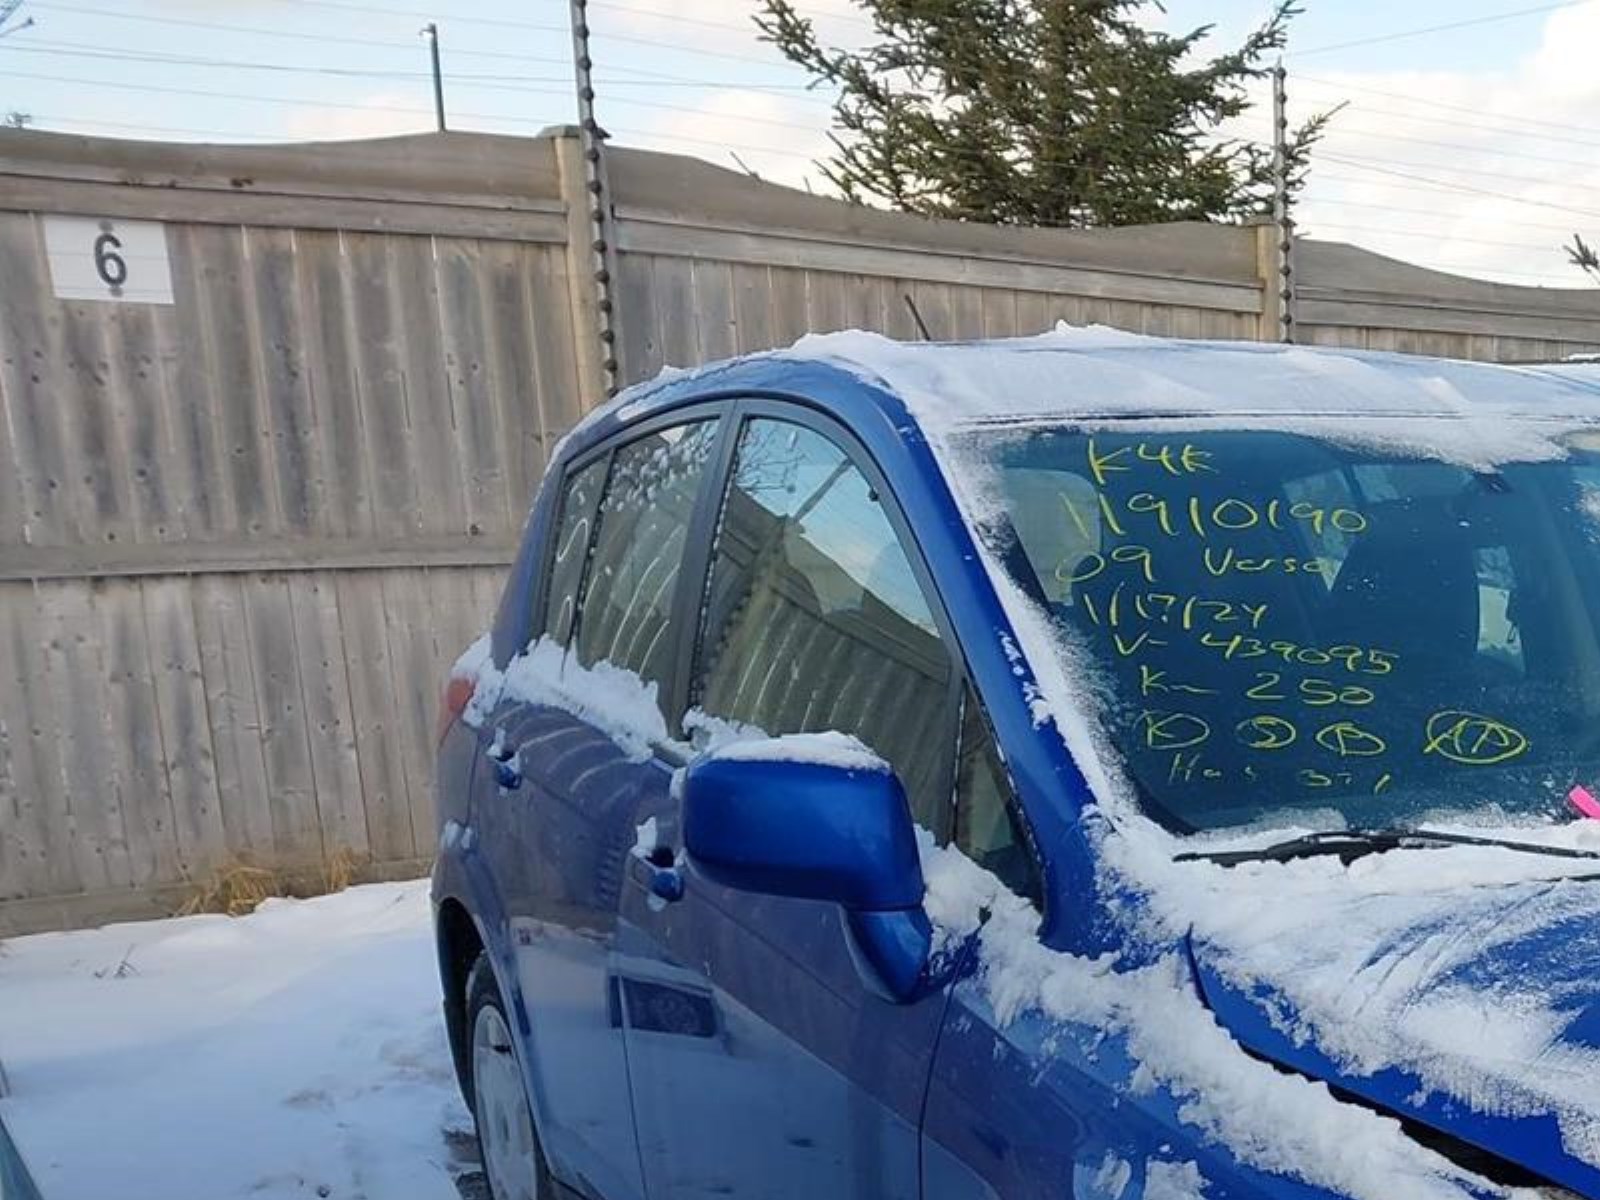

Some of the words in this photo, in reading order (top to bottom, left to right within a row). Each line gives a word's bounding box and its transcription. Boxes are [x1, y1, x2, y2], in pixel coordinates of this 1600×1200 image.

[93, 232, 128, 287] 6
[1058, 491, 1368, 538] 11910190
[1055, 545, 1158, 582] 09
